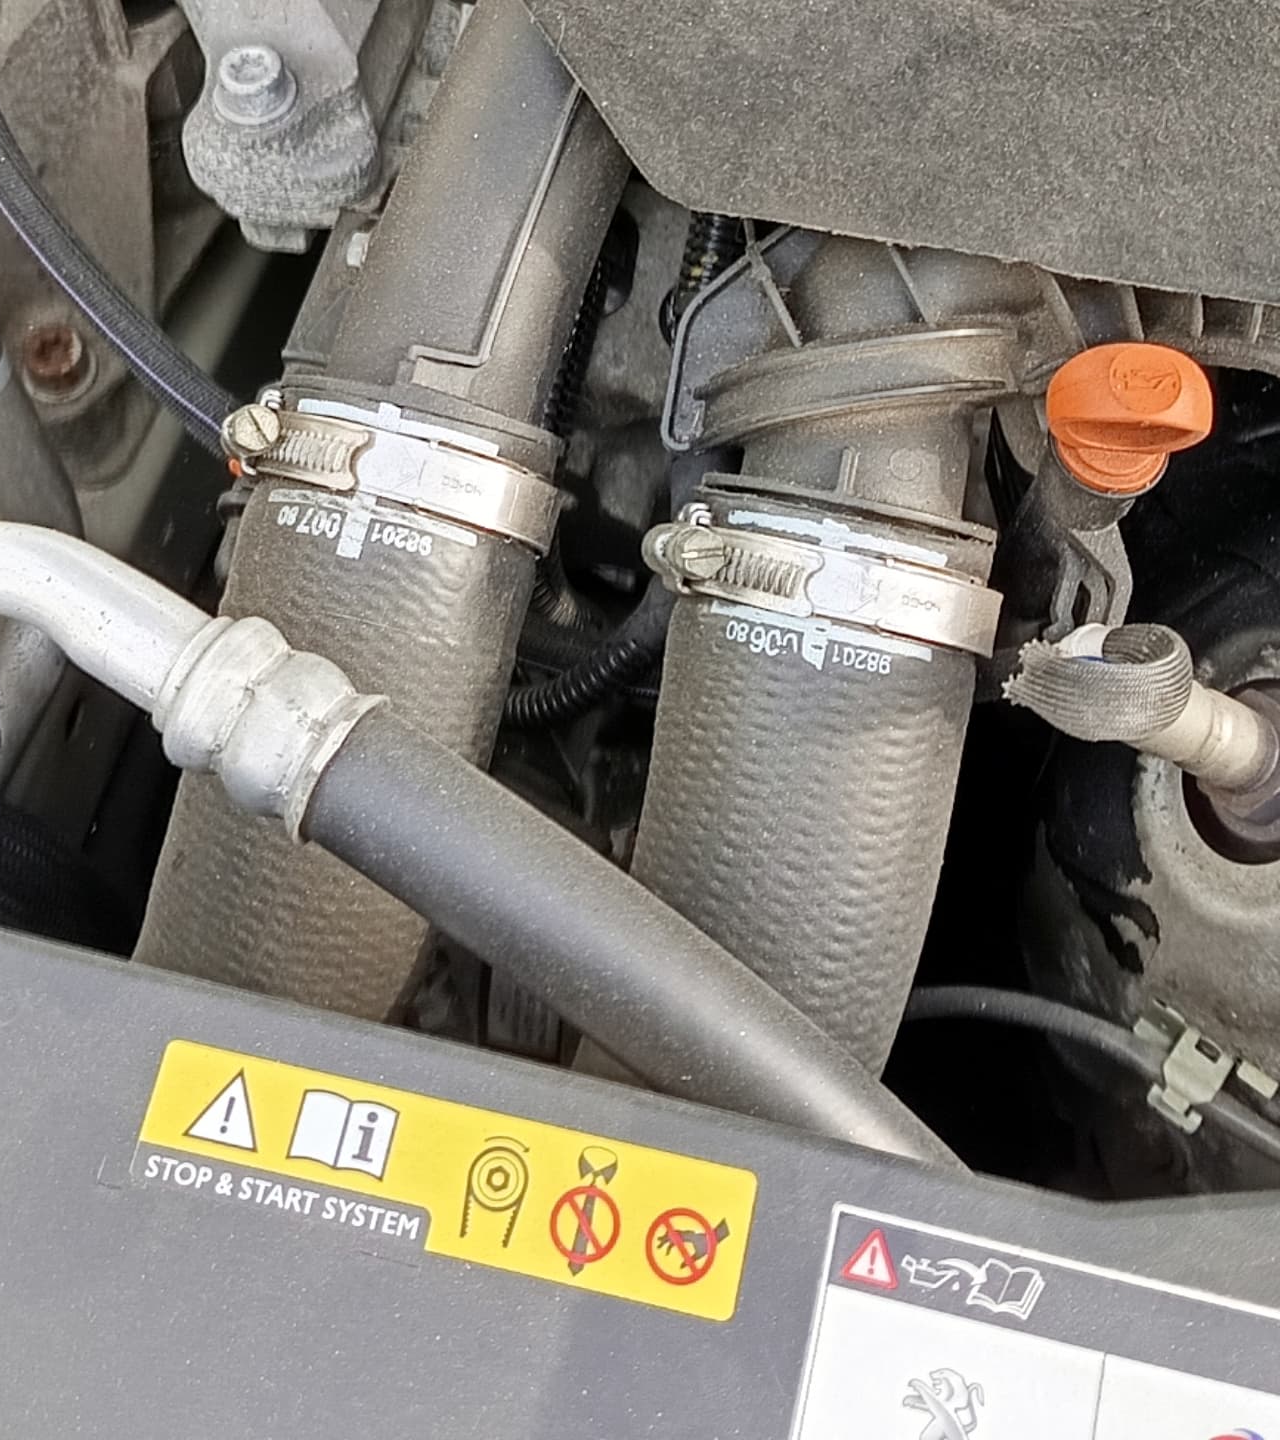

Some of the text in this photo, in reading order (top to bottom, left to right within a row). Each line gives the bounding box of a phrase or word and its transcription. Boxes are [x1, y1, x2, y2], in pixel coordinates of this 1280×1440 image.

[296, 508, 342, 538] 007
[371, 523, 432, 556] 98201
[726, 620, 749, 642] 80
[832, 644, 892, 674] 98201
[144, 1155, 420, 1240] STOP & START SYSTEM
